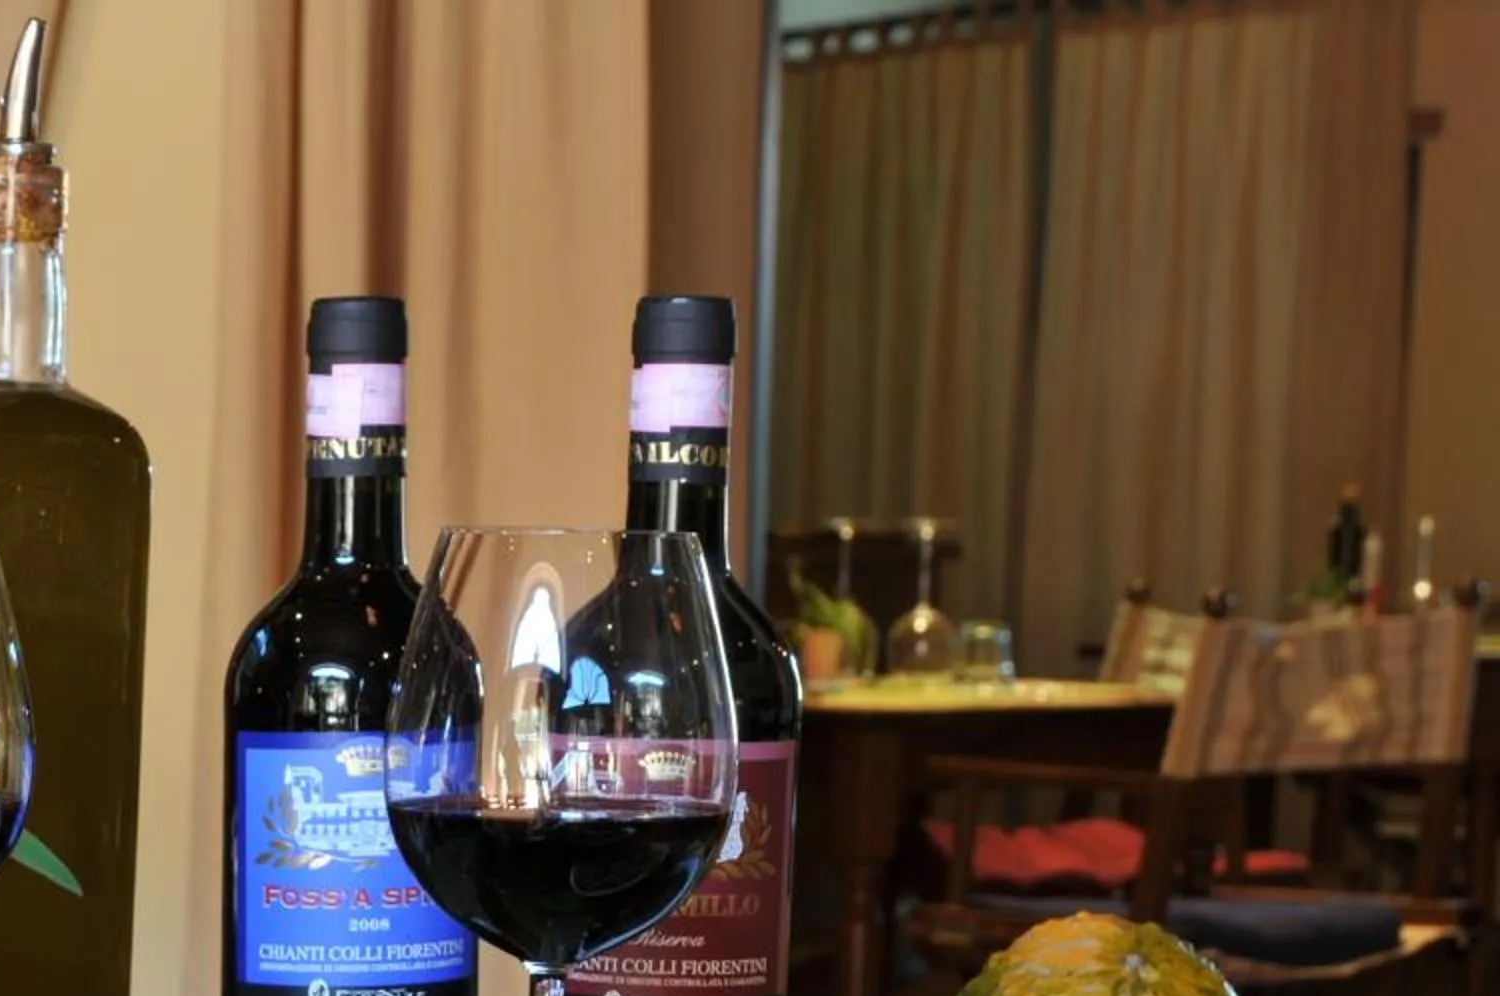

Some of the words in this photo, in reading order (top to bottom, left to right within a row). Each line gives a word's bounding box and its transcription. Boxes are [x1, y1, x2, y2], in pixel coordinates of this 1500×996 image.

[259, 943, 325, 962] CHIANTI
[328, 944, 383, 962] COLLI
[621, 957, 677, 976] COLLI
